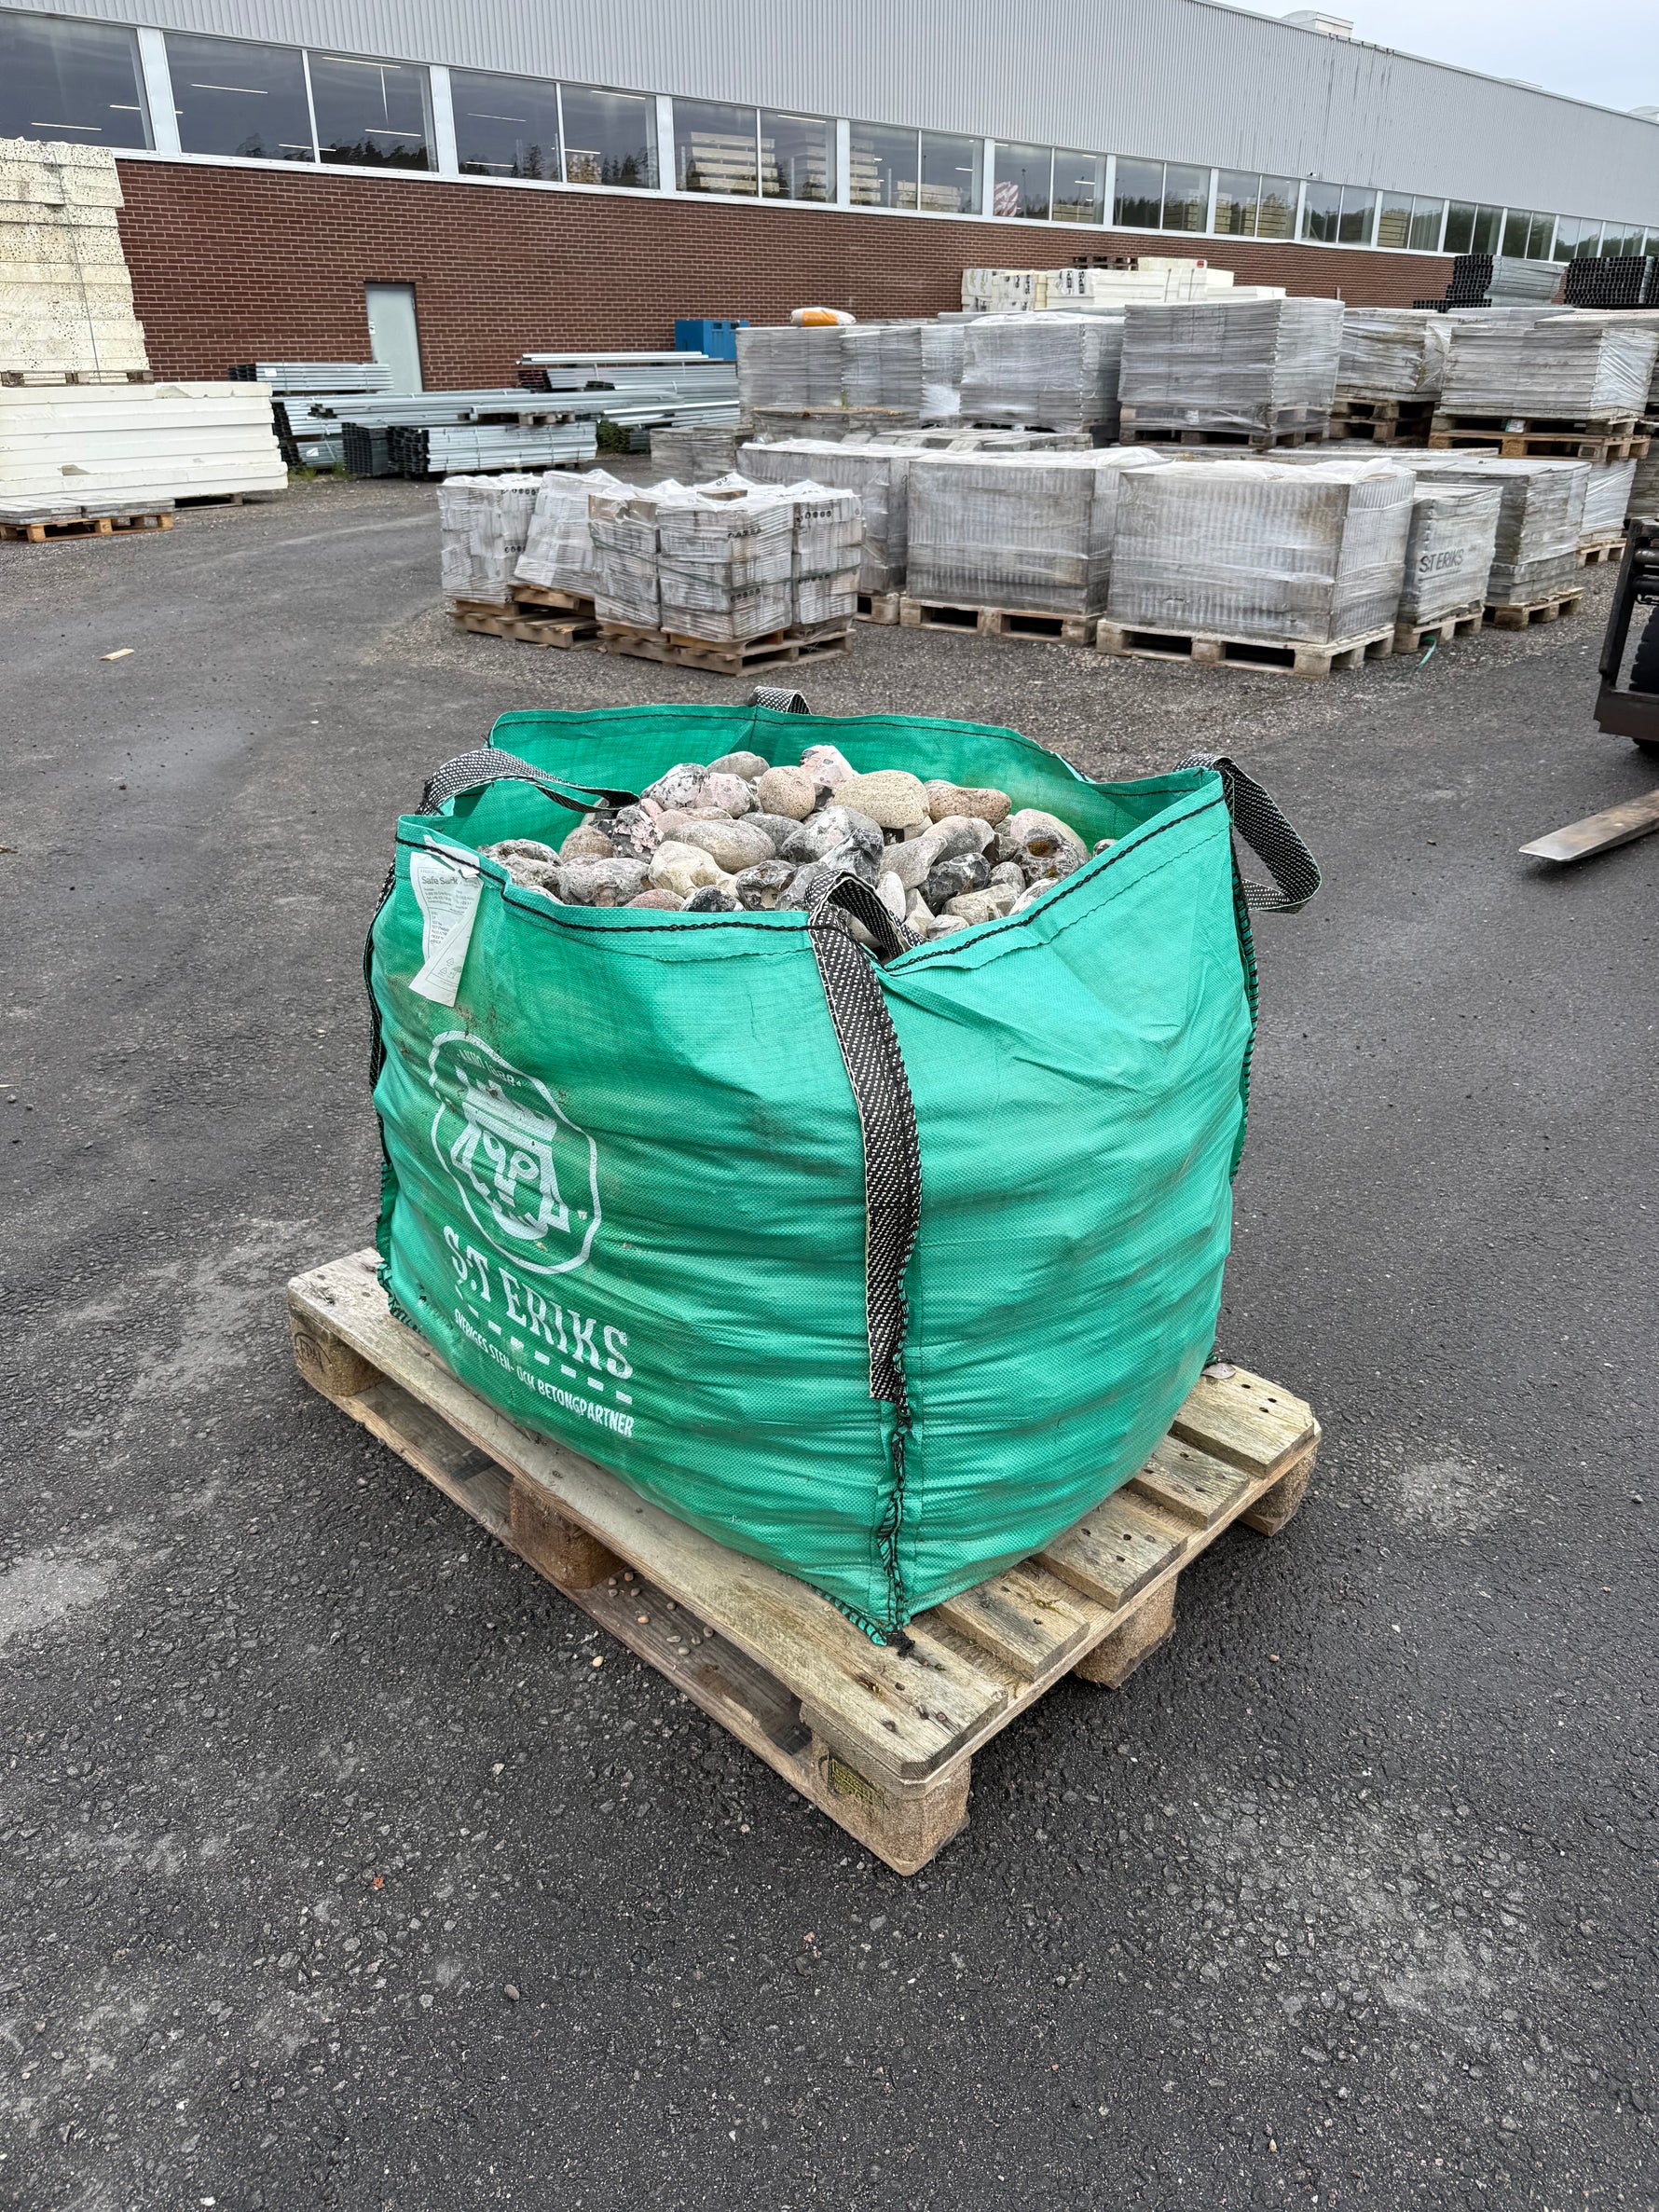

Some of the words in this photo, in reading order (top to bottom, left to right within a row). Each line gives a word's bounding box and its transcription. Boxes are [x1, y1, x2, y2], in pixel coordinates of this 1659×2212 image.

[1436, 548, 1464, 570] ERIKS
[421, 876, 438, 885] Safe
[499, 1267, 634, 1380] ERIKS
[454, 1308, 488, 1353] SVERIGES
[488, 1343, 514, 1372] STEN-
[537, 1379, 634, 1438] BETONGPARTNER
